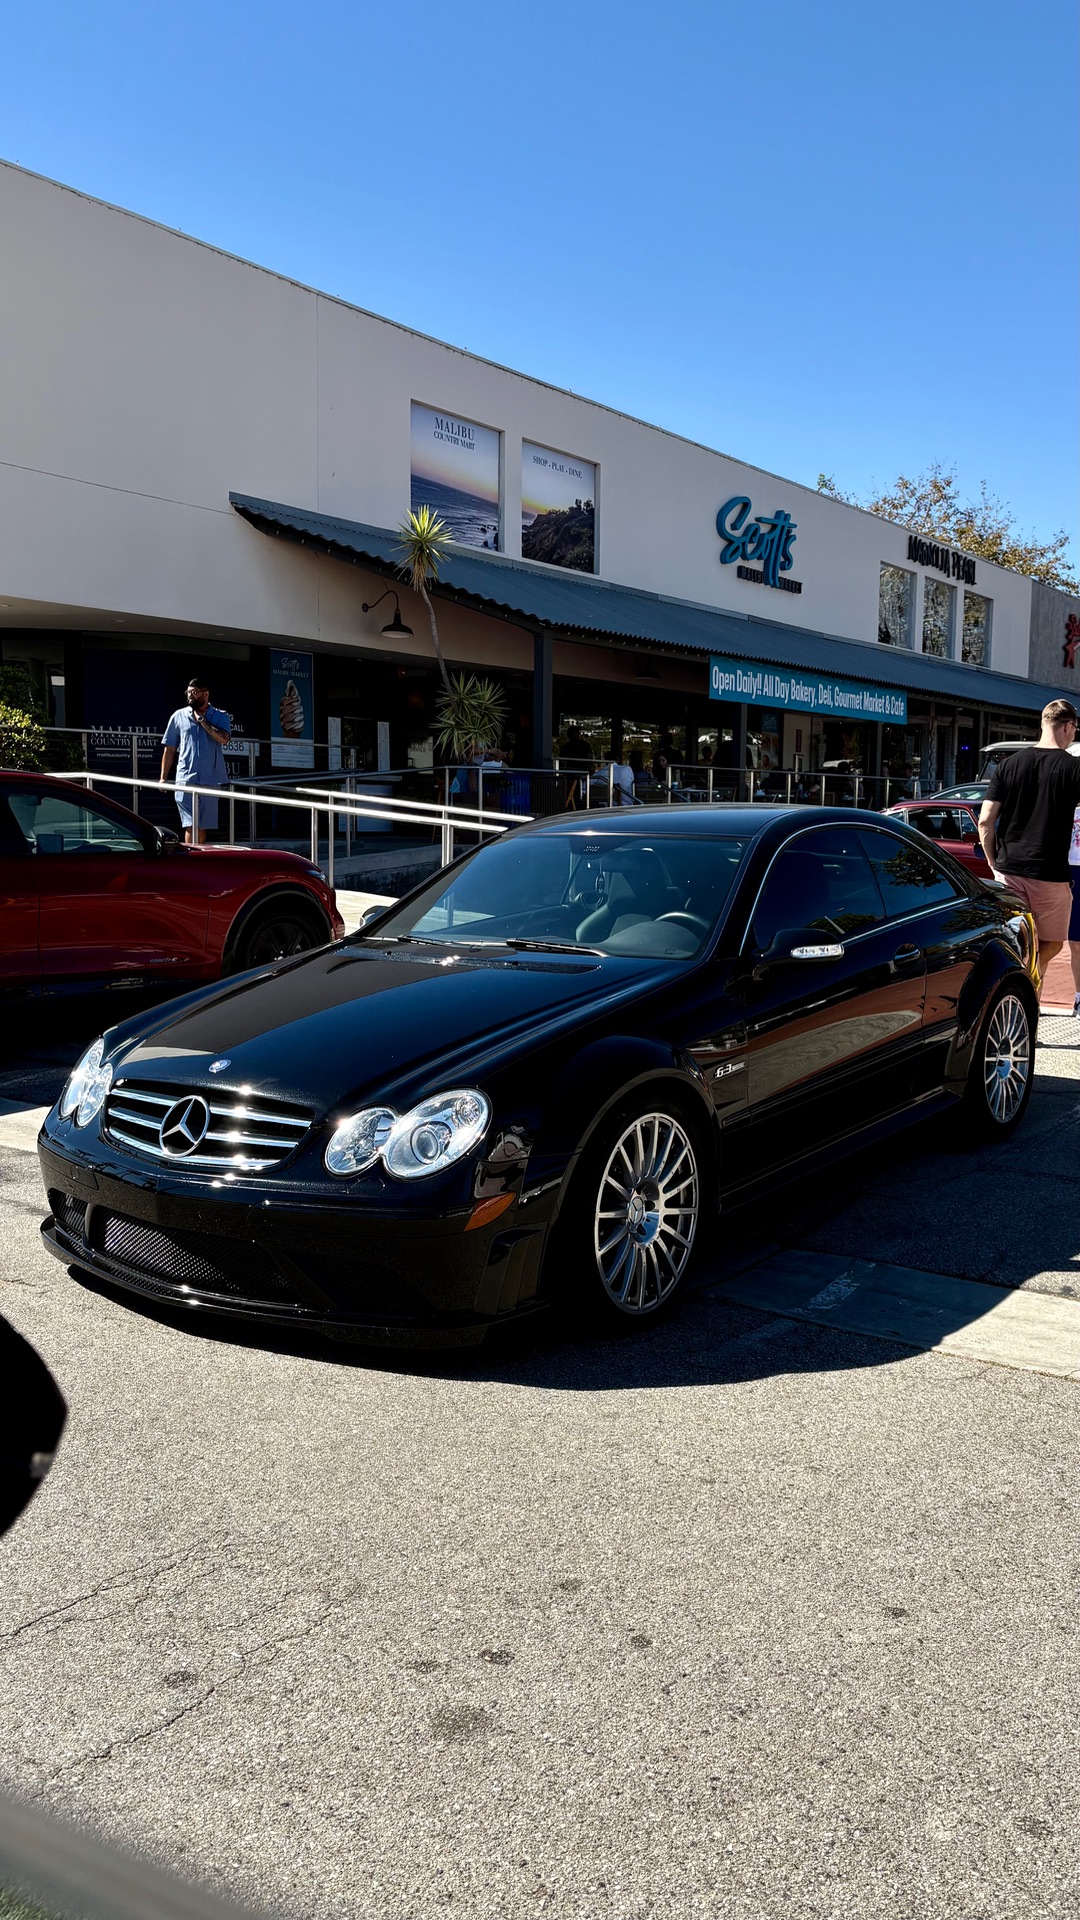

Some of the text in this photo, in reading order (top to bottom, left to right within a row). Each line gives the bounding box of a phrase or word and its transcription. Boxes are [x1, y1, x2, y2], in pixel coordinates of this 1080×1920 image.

[435, 417, 475, 441] MALIBU
[433, 430, 476, 451] COUNTRY MART
[532, 455, 583, 479] SHOP PLAY DINE
[712, 665, 736, 696] Open
[736, 669, 762, 700] Daily!!
[763, 674, 774, 697] All
[774, 676, 790, 705] Day
[790, 678, 817, 708] Bakery,
[818, 683, 833, 708] Deli,
[834, 686, 862, 710] Gourmet
[863, 691, 885, 713] Market
[885, 694, 891, 714] &
[90, 737, 131, 746] COUNTRY
[91, 725, 158, 738] MALIBU
